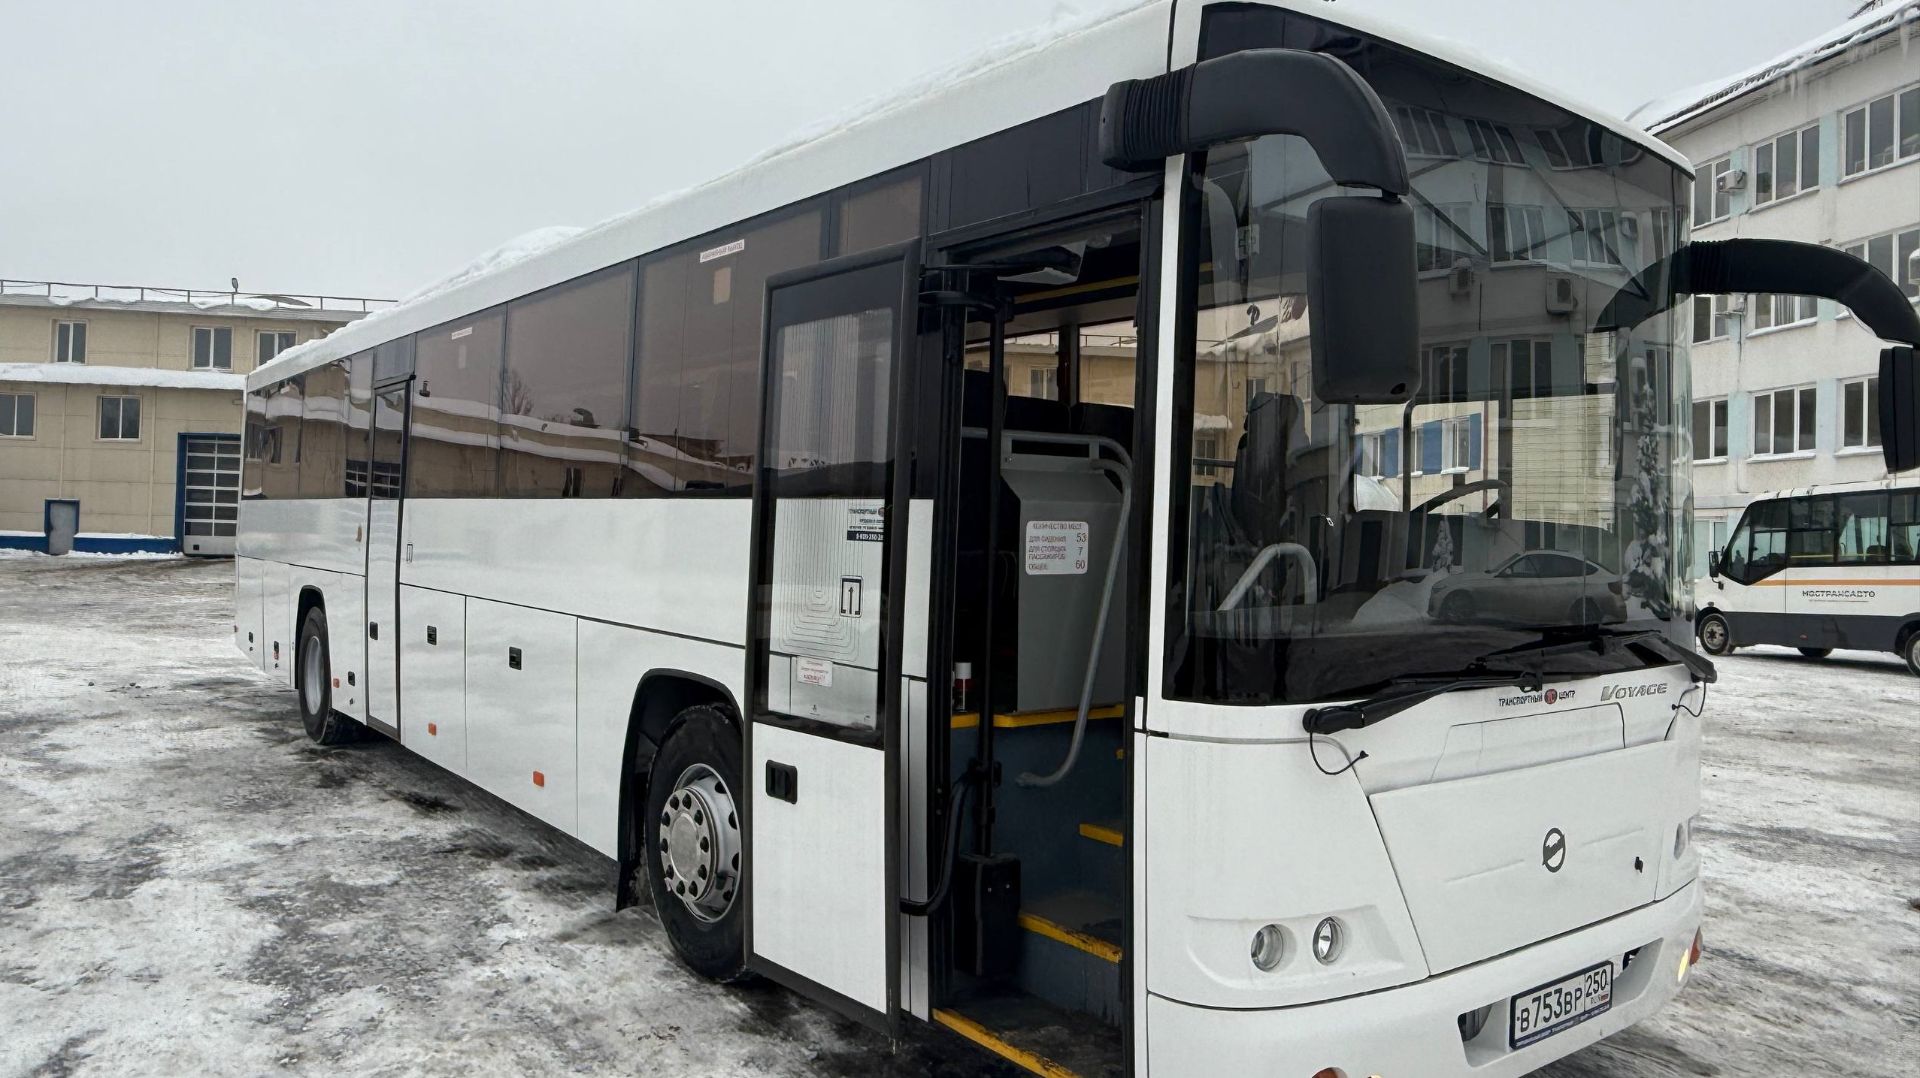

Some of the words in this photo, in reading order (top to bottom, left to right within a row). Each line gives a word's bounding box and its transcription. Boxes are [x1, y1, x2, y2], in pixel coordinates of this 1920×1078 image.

[1077, 532, 1087, 543] 53
[1077, 547, 1083, 556] 7
[1076, 560, 1085, 570] 60
[1499, 692, 1542, 707] ТРАНСПОРТНЫЙ
[1559, 690, 1576, 700] ЦЕНТР
[1585, 968, 1608, 998] 250
